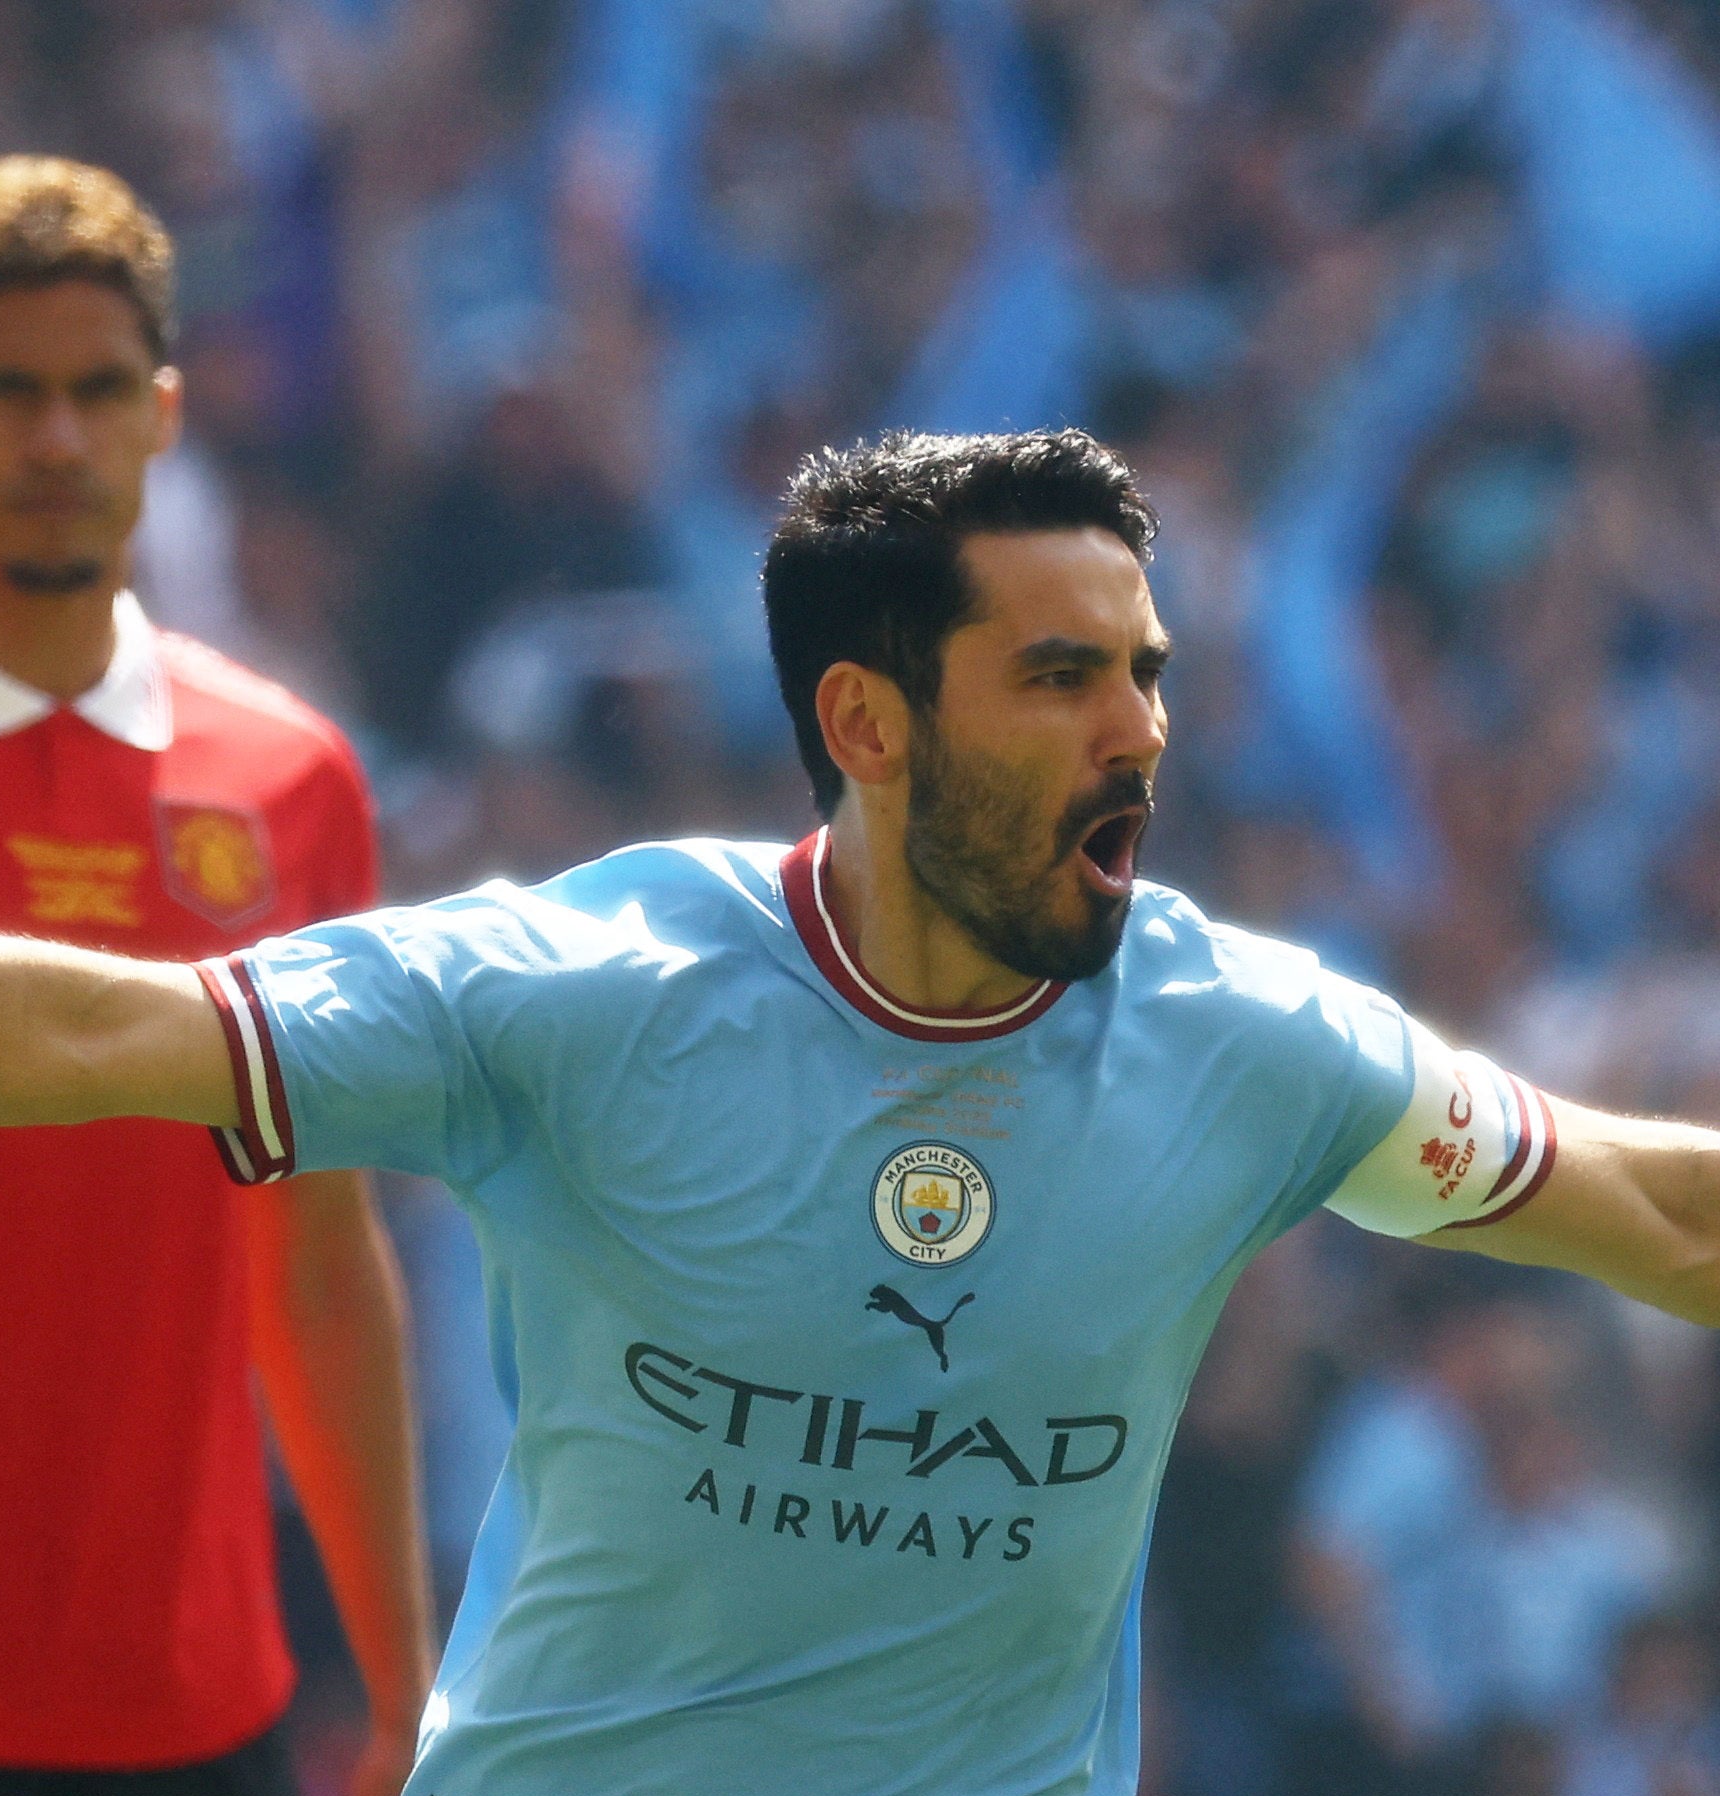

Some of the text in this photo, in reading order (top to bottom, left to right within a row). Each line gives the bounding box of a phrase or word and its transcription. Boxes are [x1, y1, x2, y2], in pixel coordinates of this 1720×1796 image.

[885, 1150, 983, 1194] MANCHESTER
[1438, 1138, 1476, 1200] FA CUP
[909, 1245, 947, 1260] CITY
[624, 1341, 1128, 1488] ETIHAD
[684, 1468, 1037, 1563] AIRWAYS
